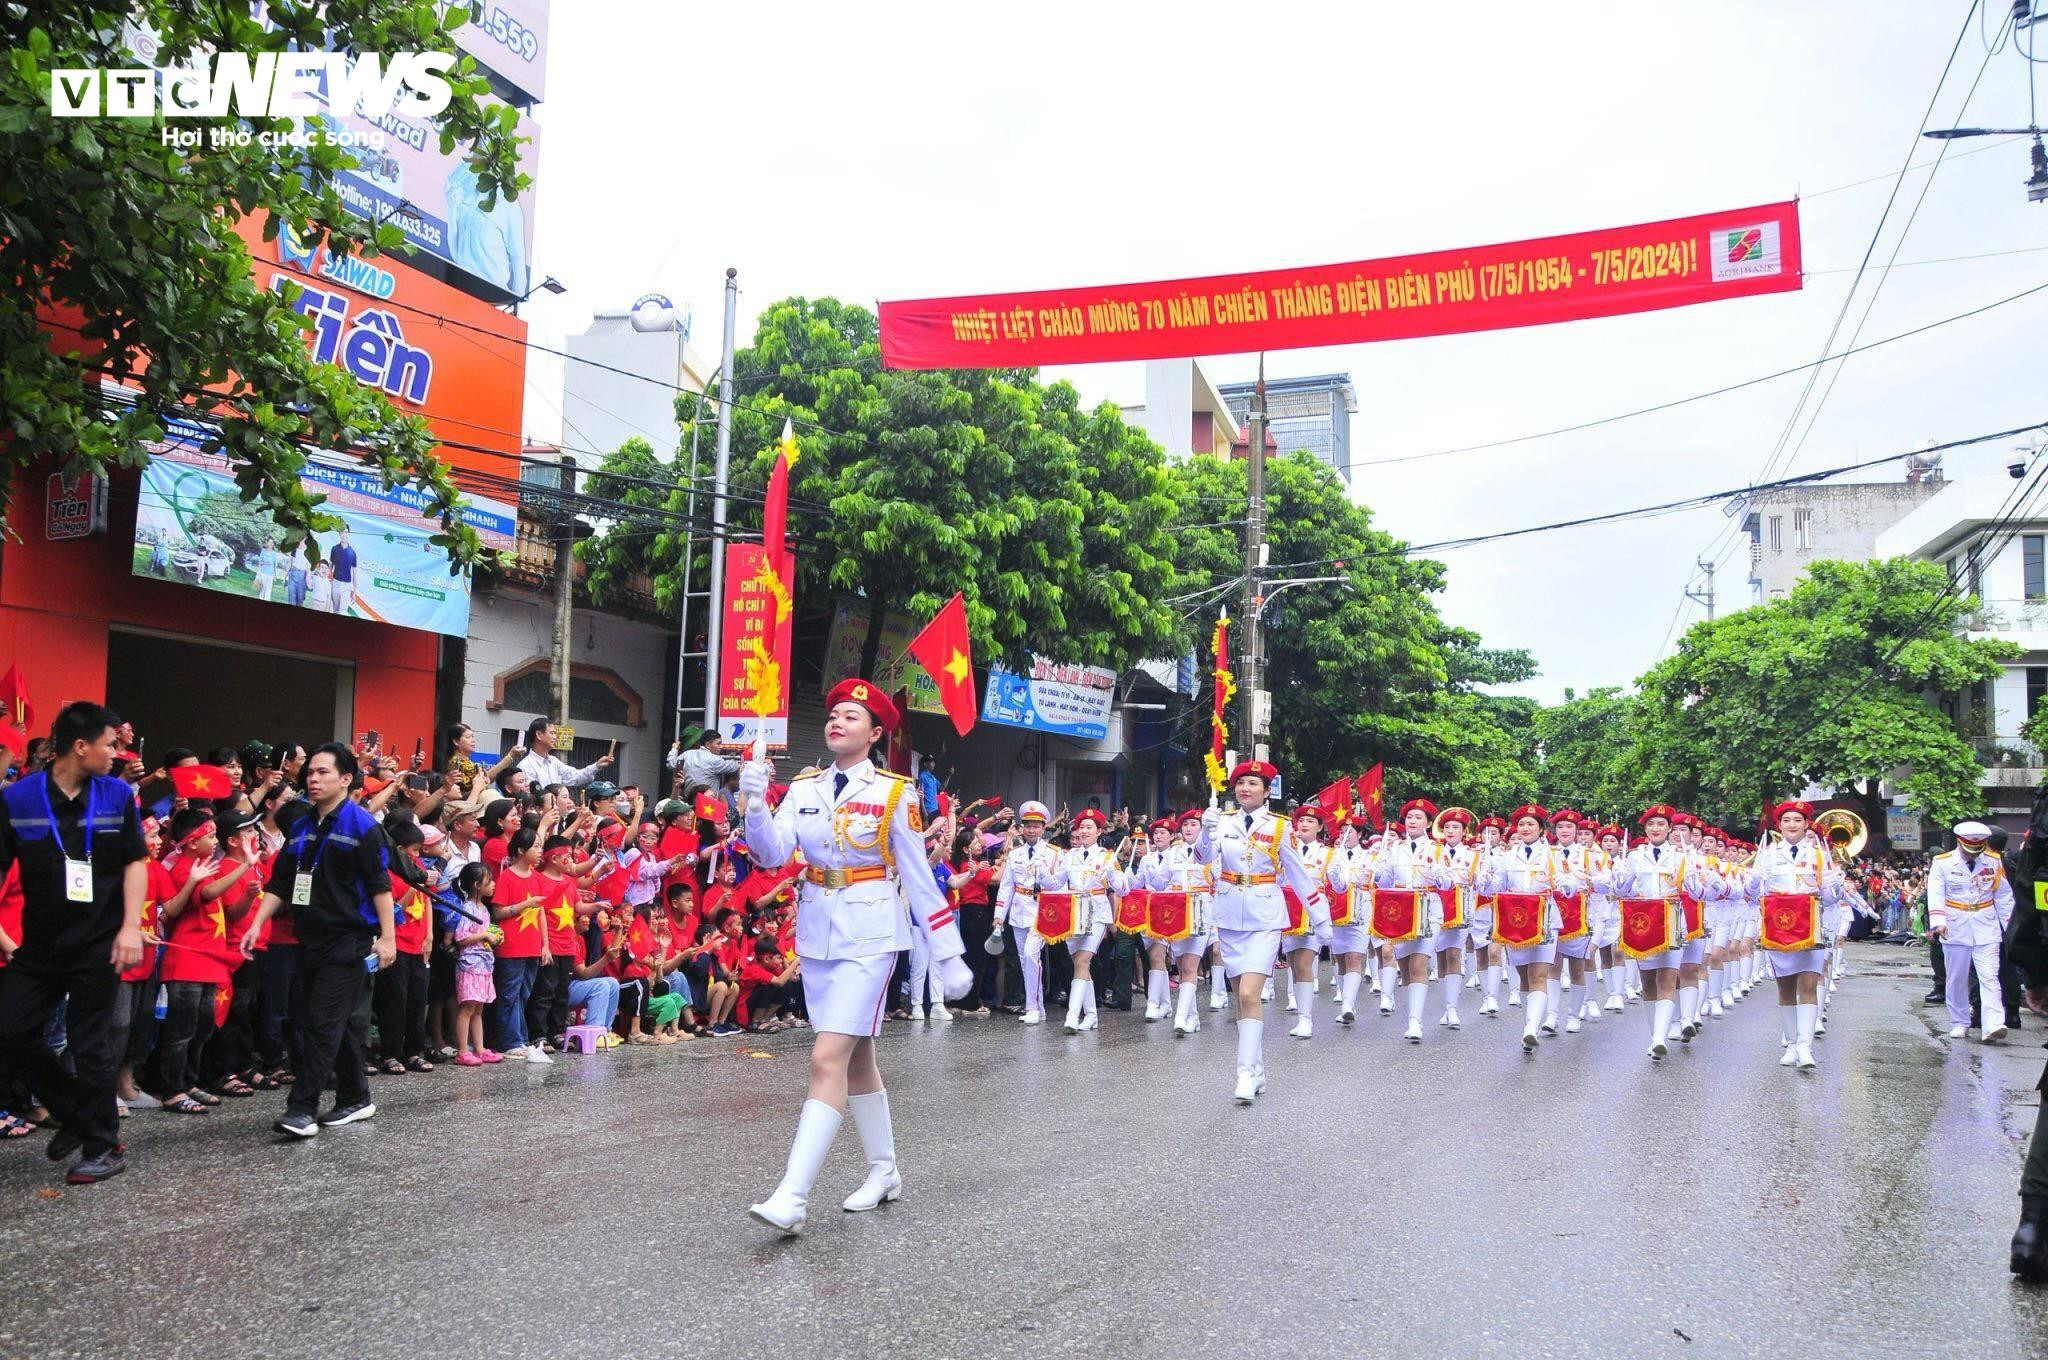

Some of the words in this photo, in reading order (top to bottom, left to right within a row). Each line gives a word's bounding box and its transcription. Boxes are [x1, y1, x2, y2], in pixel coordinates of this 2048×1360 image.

[331, 176, 373, 213] Hotline:
[322, 251, 395, 298] SAWAD
[1717, 263, 1776, 278] AGRIBANK
[951, 307, 999, 345] NHIỆT
[1000, 304, 1036, 344] LIỆT
[1038, 301, 1085, 338] CHÀO
[1087, 298, 1141, 334] MỪNG
[1142, 299, 1166, 330] 70
[1168, 291, 1211, 329] NĂM
[1213, 284, 1269, 325] CHIẾN
[1335, 273, 1382, 317] ĐIỆN
[1385, 268, 1432, 310] BIÊN
[1434, 260, 1475, 304] PHỦ
[1479, 256, 1573, 302] (7/5/1954
[1577, 268, 1587, 277] -
[1590, 238, 1698, 286] 7/5/2024)!
[732, 596, 745, 612] HỒ
[745, 597, 760, 612] CHÍ
[736, 634, 754, 651] SỐN
[75, 876, 84, 888] C
[298, 892, 305, 902] C
